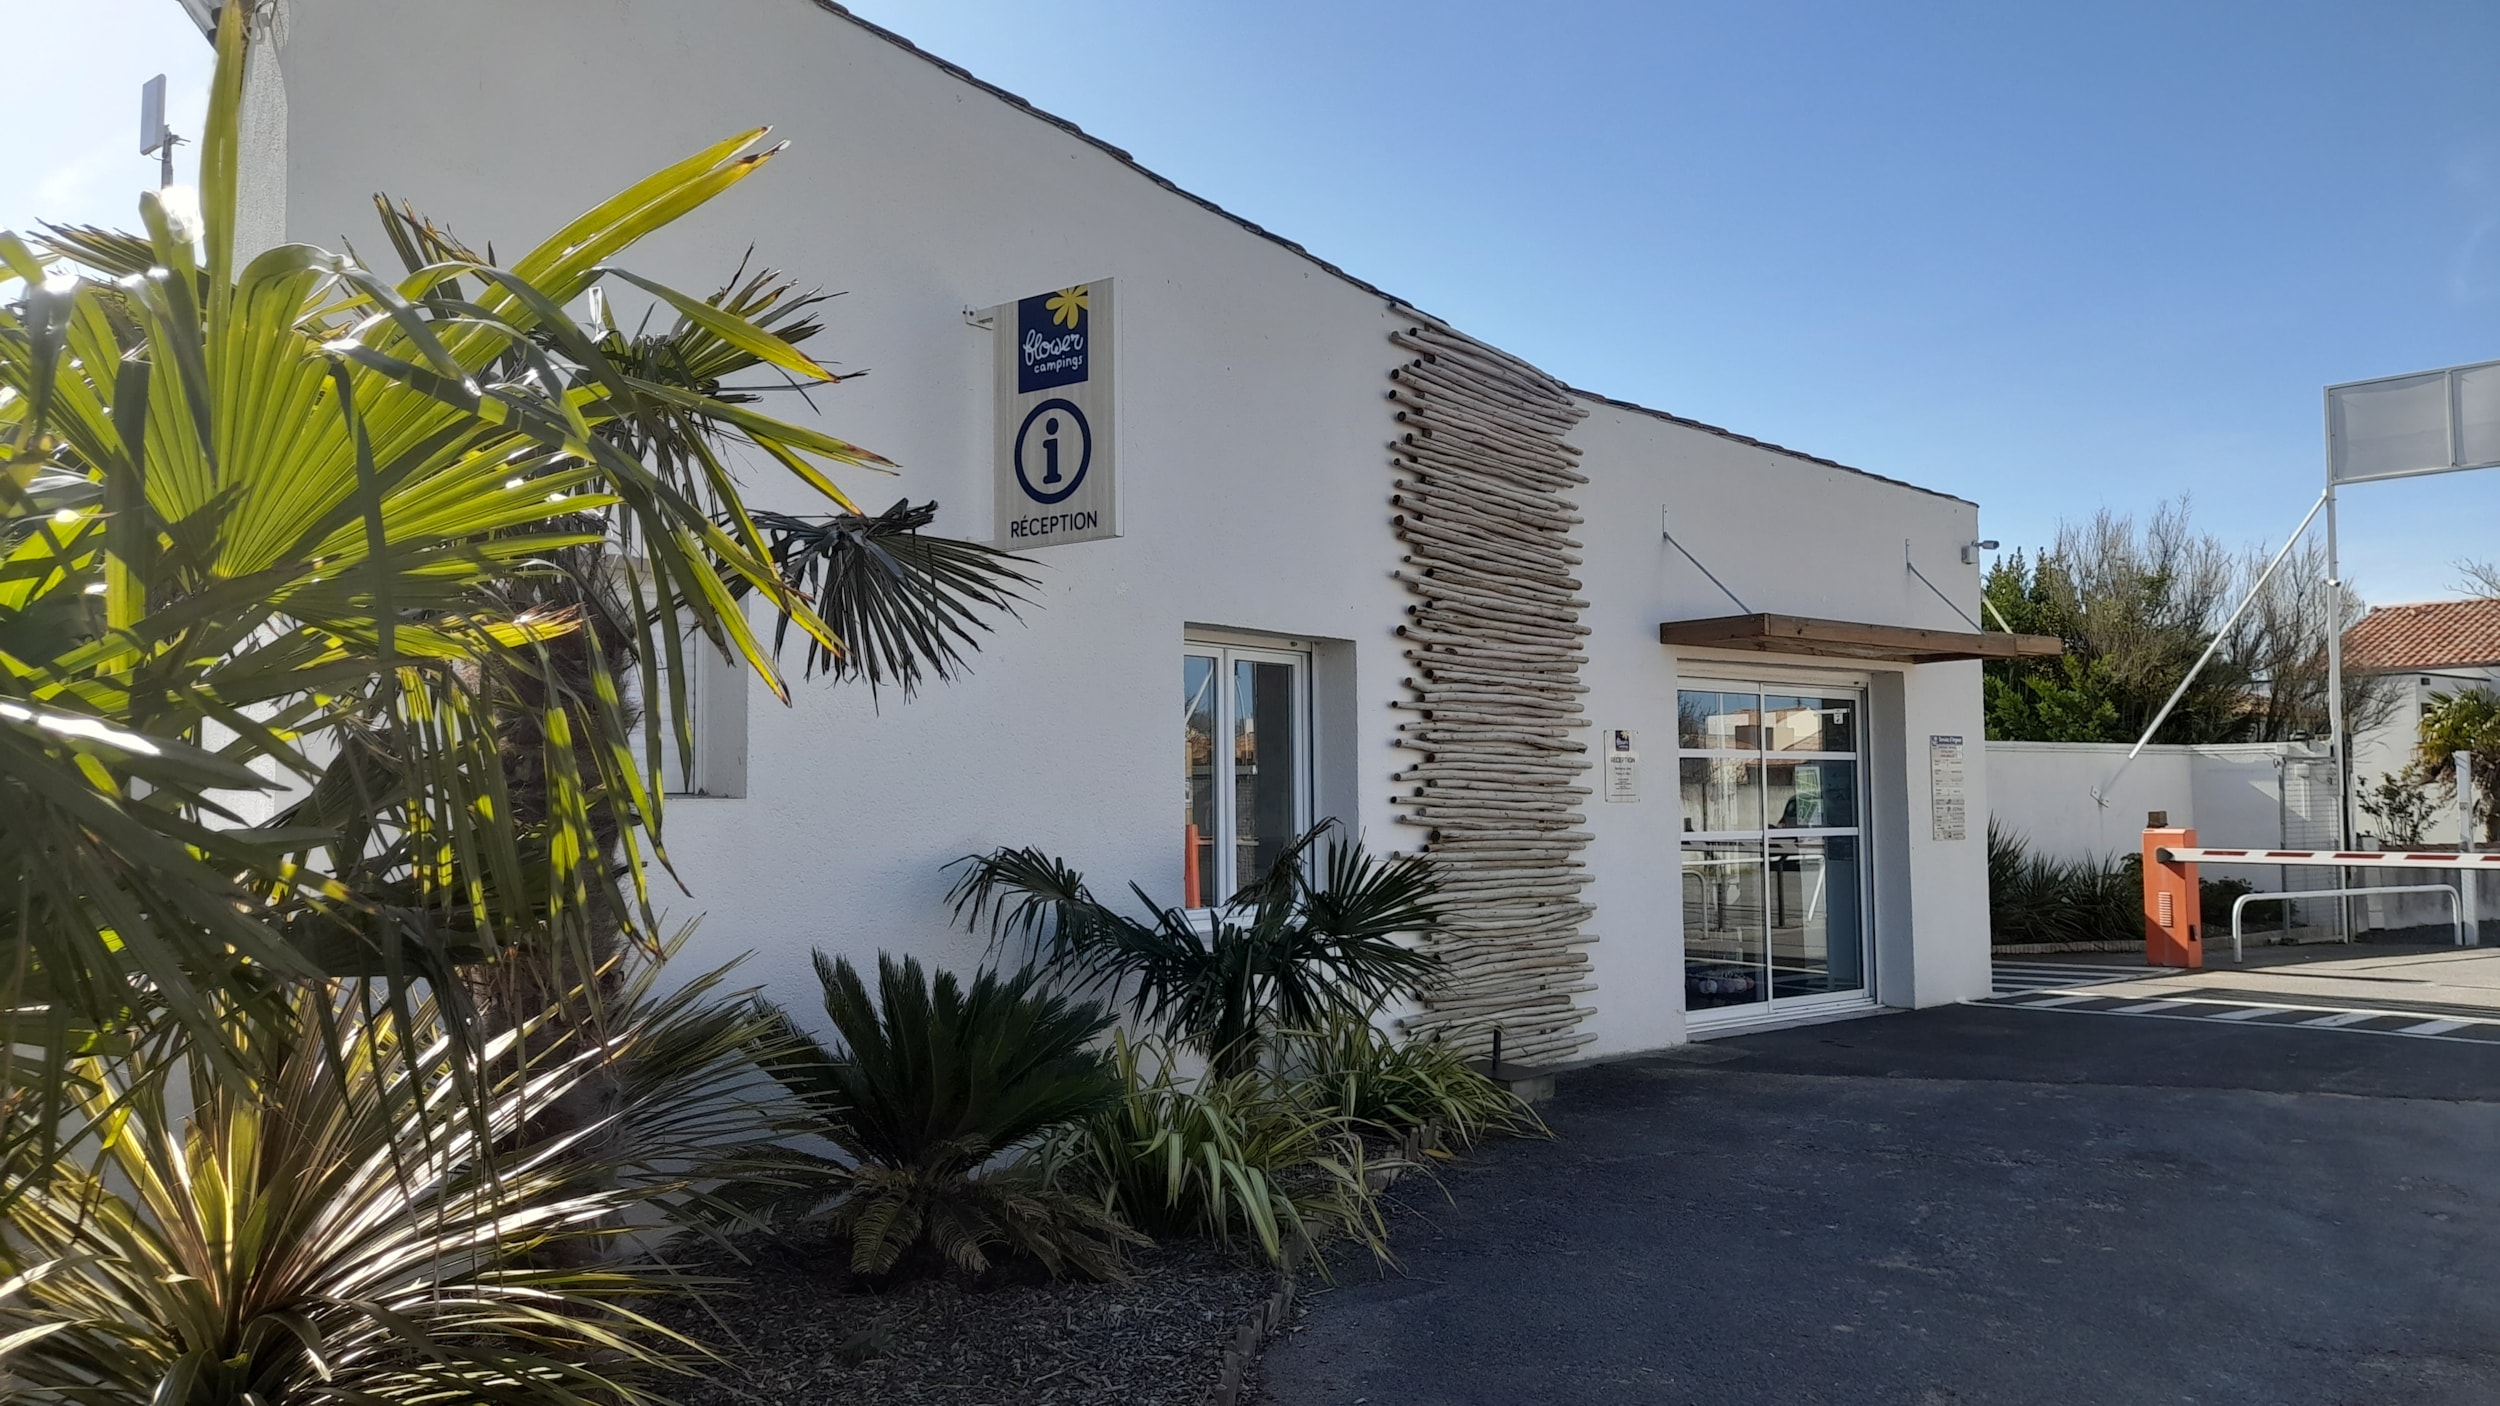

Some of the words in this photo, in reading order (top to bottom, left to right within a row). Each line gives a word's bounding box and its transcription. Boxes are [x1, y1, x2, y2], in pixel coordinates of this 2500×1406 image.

[1022, 329, 1084, 366] flower
[1034, 355, 1083, 374] campings
[1011, 510, 1098, 539] RÉCEPTION
